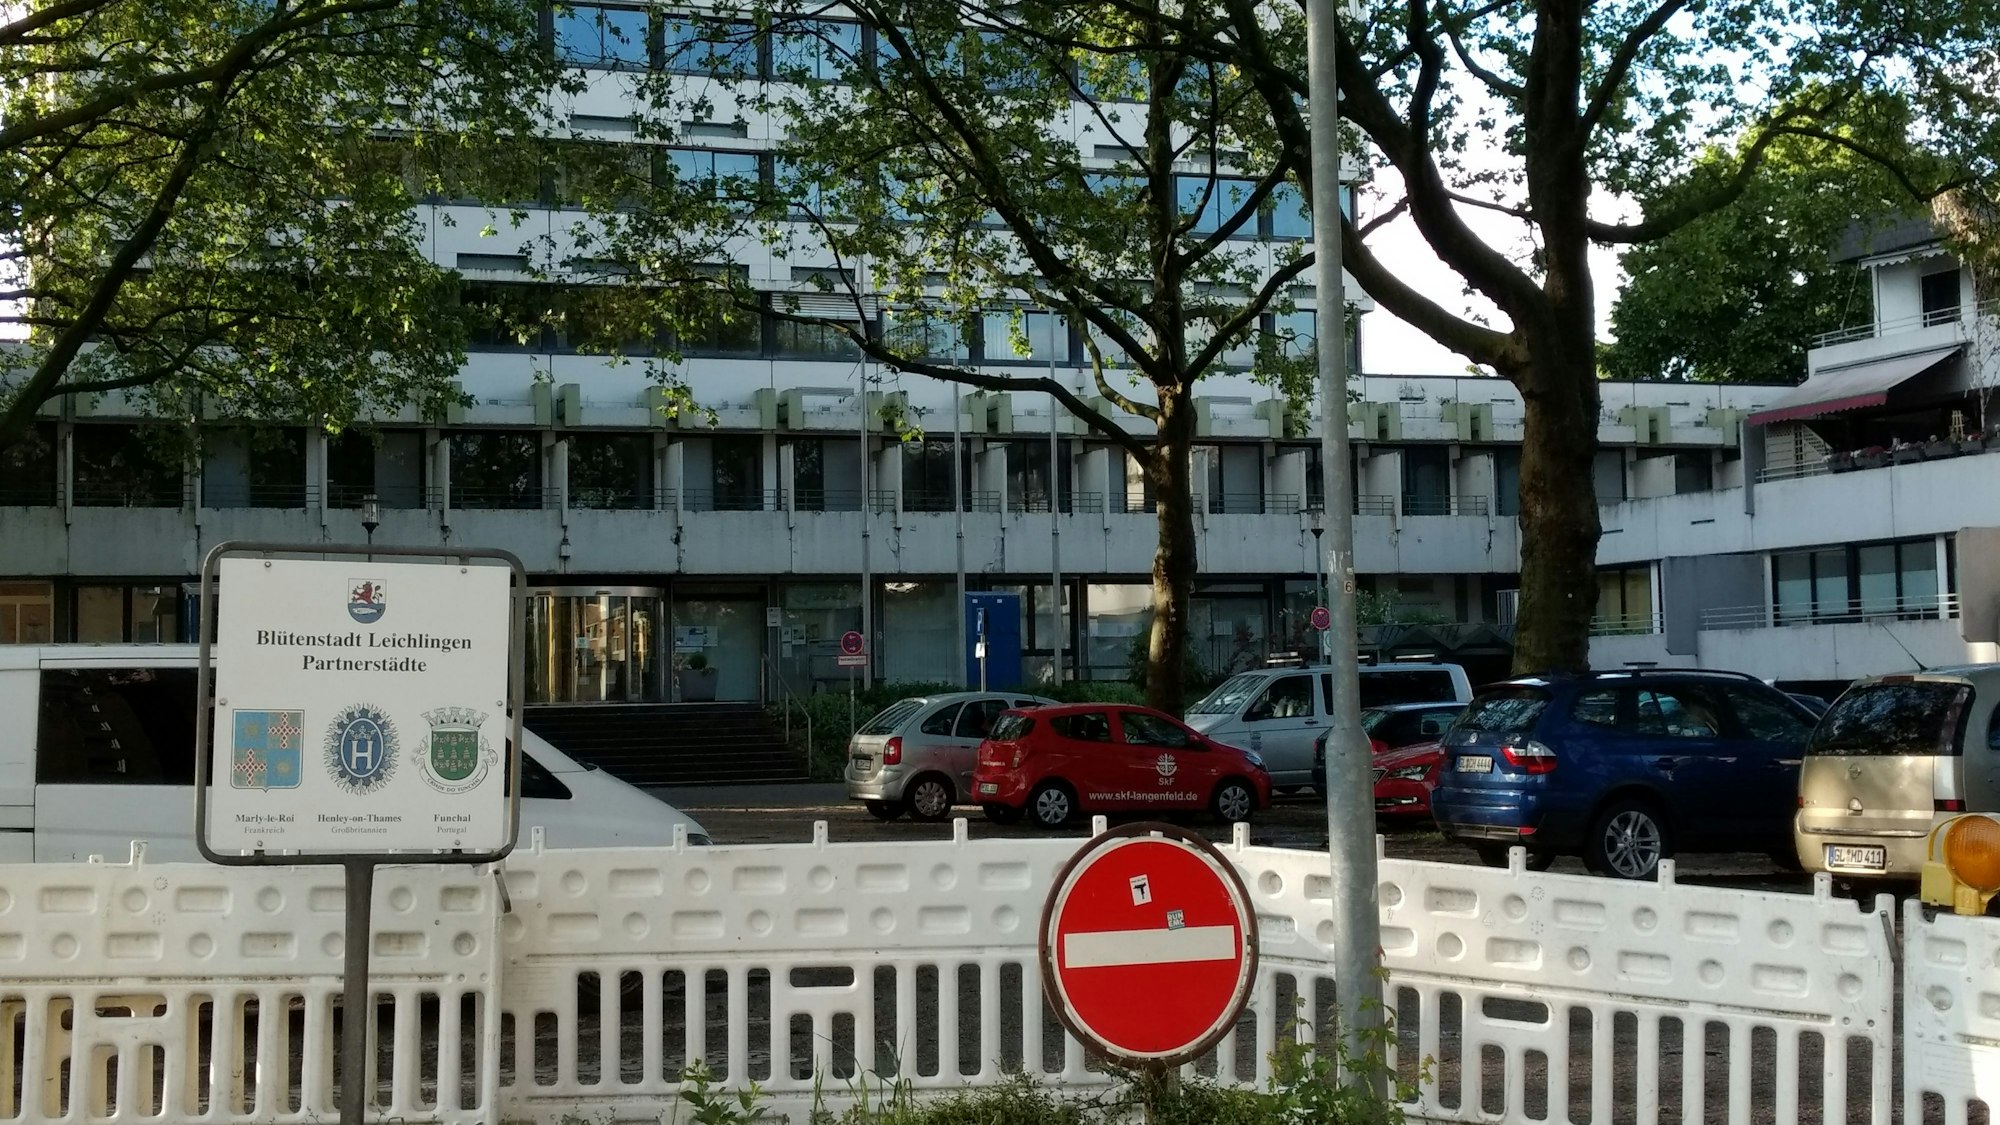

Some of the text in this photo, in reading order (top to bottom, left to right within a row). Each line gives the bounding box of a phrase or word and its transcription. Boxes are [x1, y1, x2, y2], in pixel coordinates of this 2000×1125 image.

[1345, 582, 1352, 592] 6
[257, 630, 472, 652] Blütenstadt Leichlingen
[302, 655, 427, 672] Partnerstädte
[350, 740, 374, 770] H
[1158, 777, 1175, 786] SkF
[1088, 791, 1198, 803] www.skf-langenfeld.de
[235, 814, 295, 824] Marly-le-Roi
[317, 814, 402, 824] Henley-on-Thames
[434, 814, 471, 823] Funchal
[244, 826, 285, 834] Frankreich
[331, 826, 387, 834] Großbritannien
[437, 826, 467, 835] Portugal
[1834, 849, 1845, 862] GL
[1865, 851, 1882, 864] 411
[1167, 911, 1184, 921] RUN
